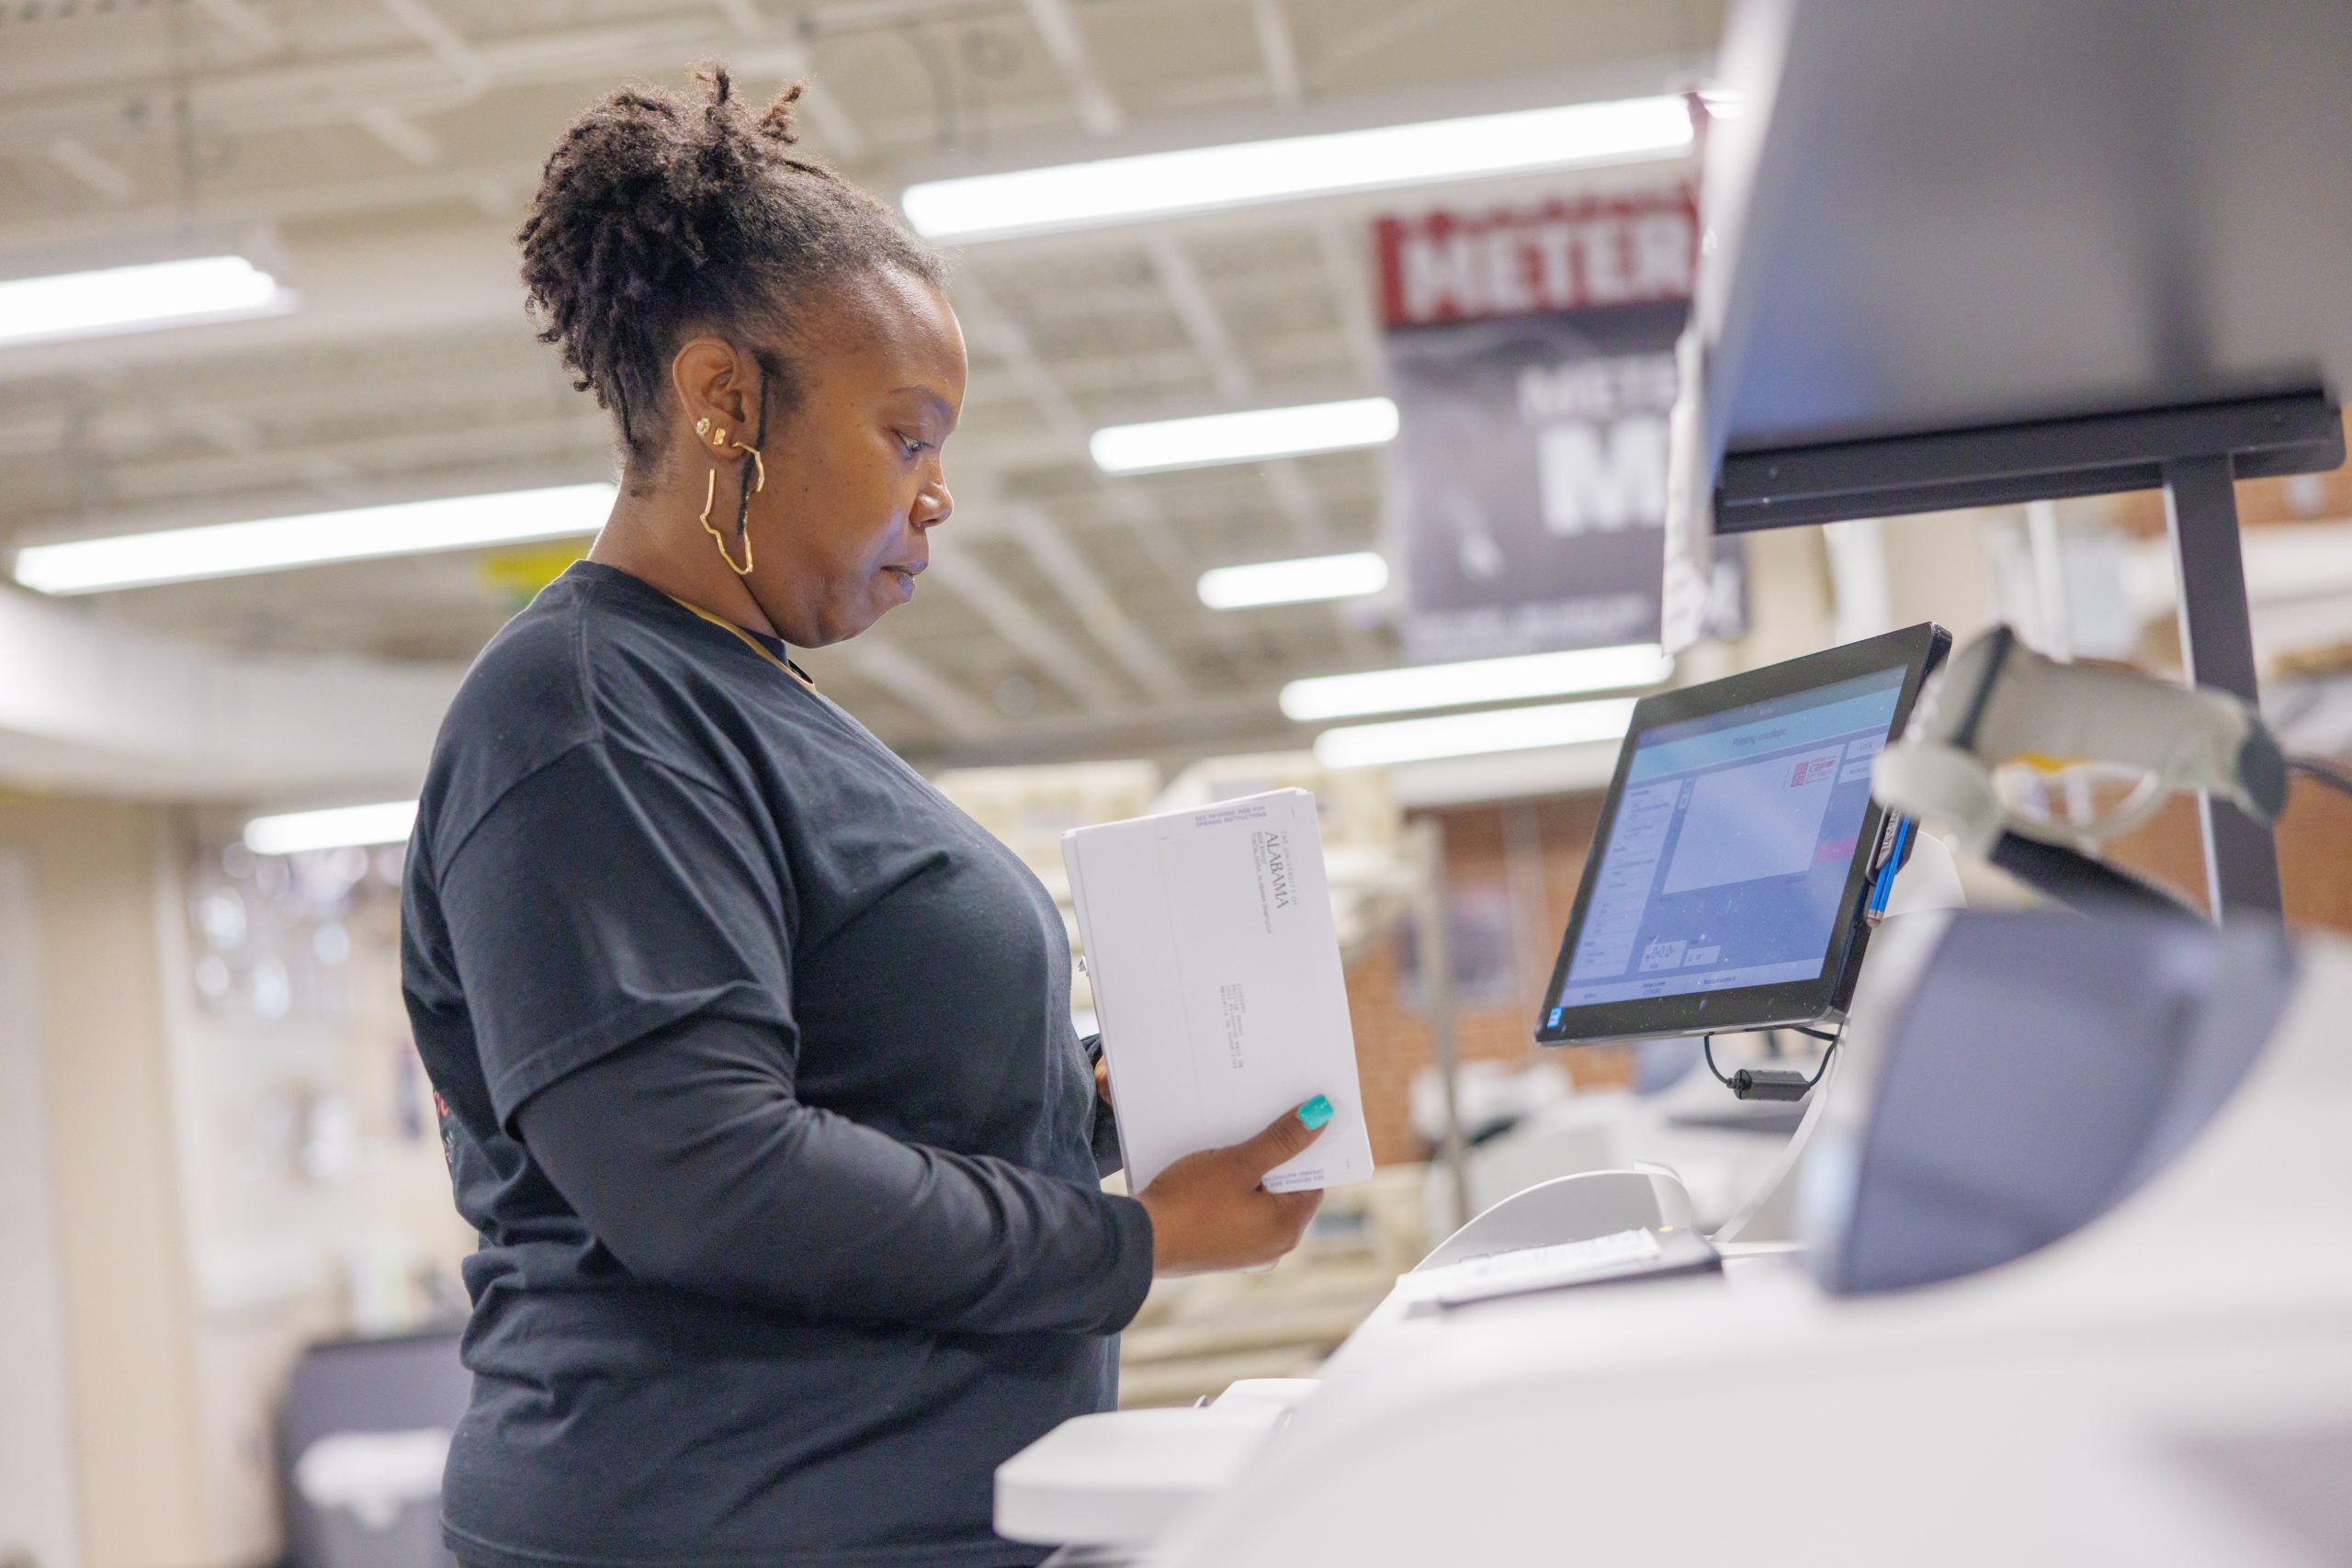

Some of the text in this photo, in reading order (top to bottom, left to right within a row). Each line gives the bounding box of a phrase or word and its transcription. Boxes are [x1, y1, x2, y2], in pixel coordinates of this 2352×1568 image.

[1208, 809, 1235, 818] REVERSE
[1264, 829, 1289, 908] ALABAMA
[1280, 830, 1297, 906] THE UNIVERSITY OF
